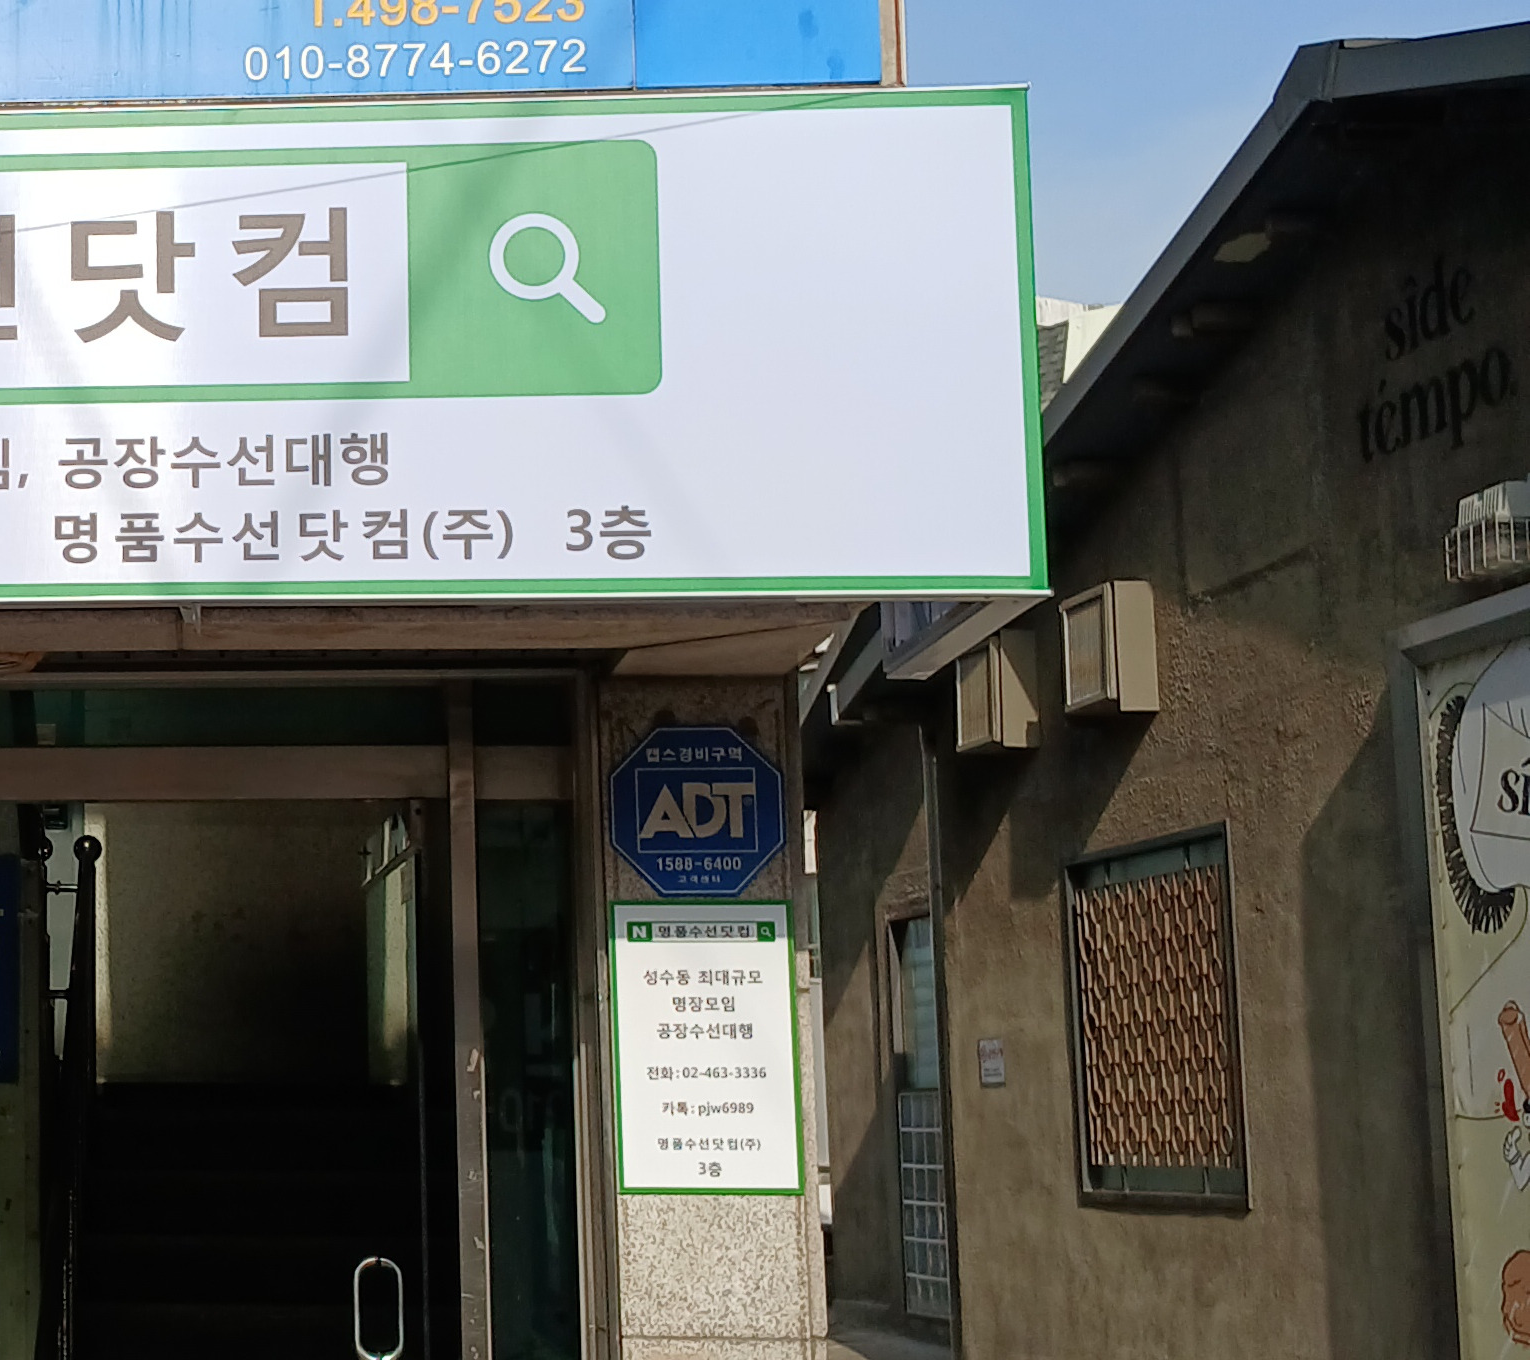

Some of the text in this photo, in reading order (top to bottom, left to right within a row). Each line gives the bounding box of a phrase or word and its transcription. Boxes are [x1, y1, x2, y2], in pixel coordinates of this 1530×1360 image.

[244, 38, 587, 82] 010-8774-6272
[58, 432, 390, 490] 공장수선대행
[54, 507, 514, 564] 명품수선닷컴(주)
[565, 504, 653, 561] 3층
[645, 746, 743, 764] 캡스경비구역
[638, 781, 757, 840] ADT
[655, 856, 743, 872] 1588-6400
[643, 968, 763, 987] 성수동 최대규모
[672, 995, 736, 1013] 명장모임
[656, 1022, 753, 1040] 공장수선대행
[698, 1161, 723, 1178] 3층
